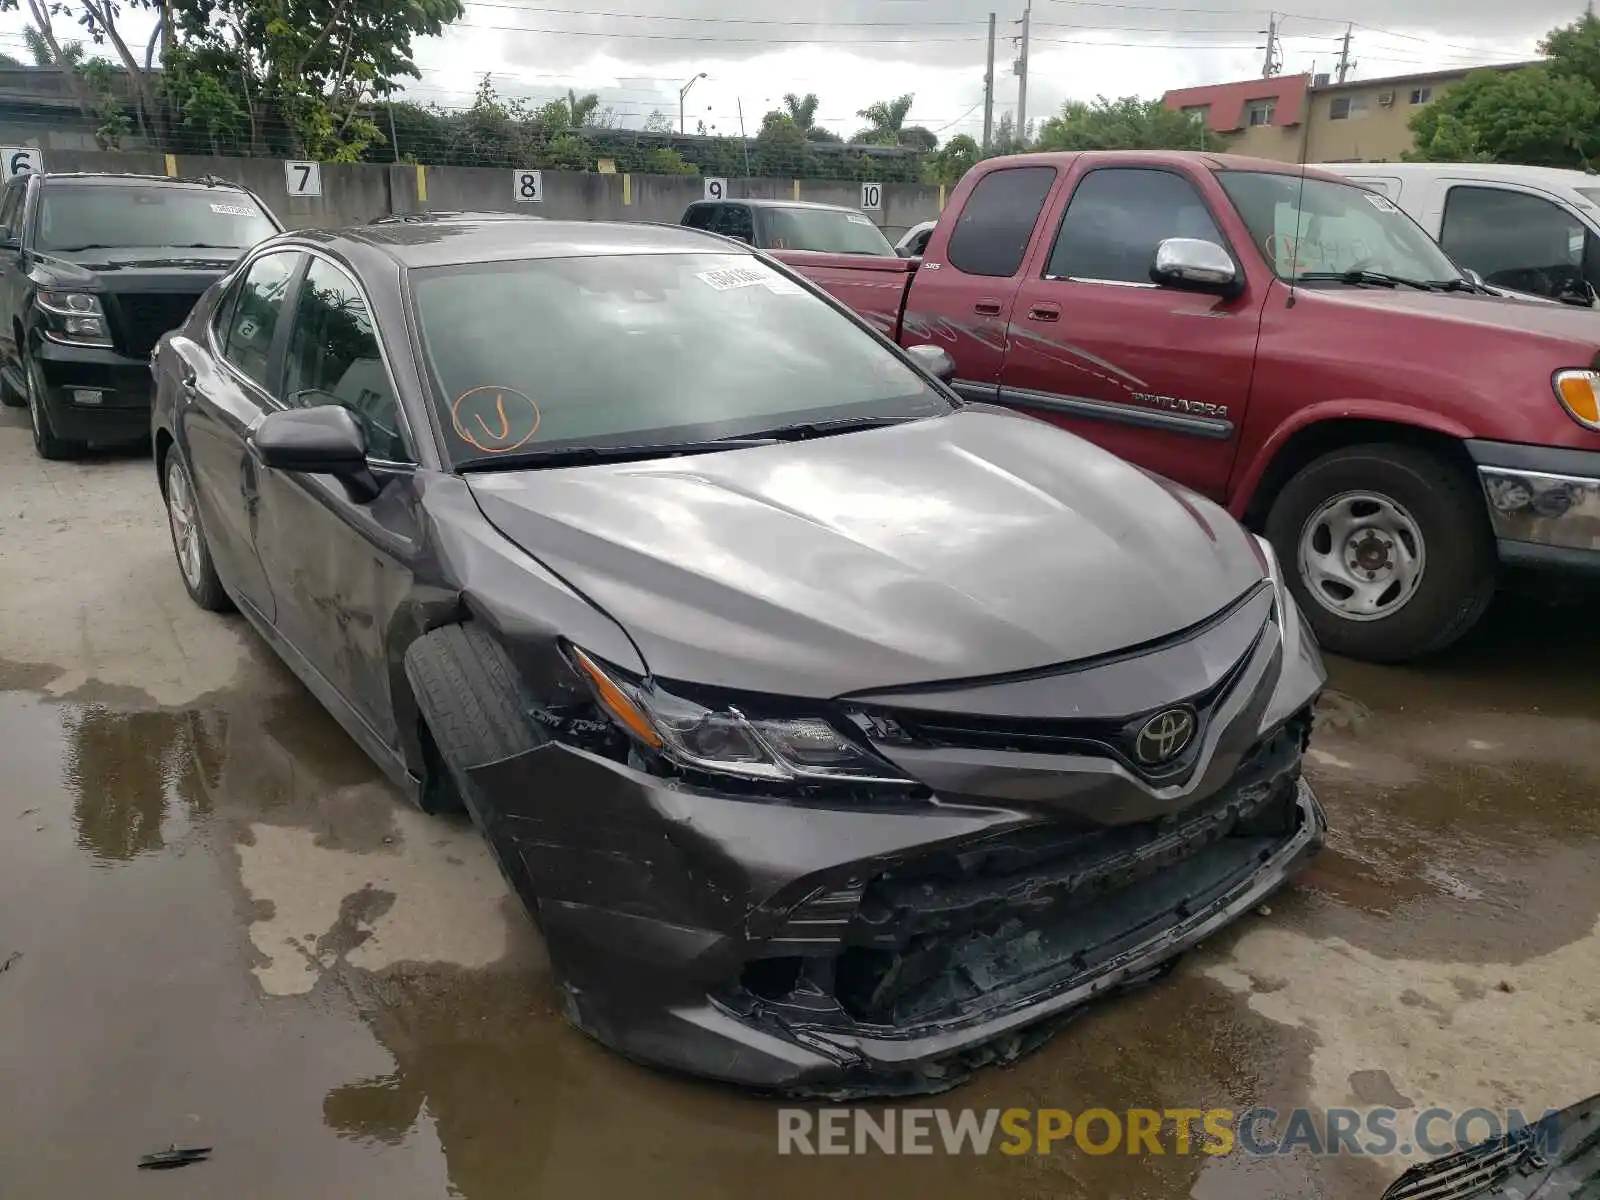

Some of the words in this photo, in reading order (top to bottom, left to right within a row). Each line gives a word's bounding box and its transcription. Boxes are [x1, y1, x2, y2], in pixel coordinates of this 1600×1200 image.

[11, 152, 31, 175] 6
[293, 165, 311, 191] 7
[520, 174, 536, 198] 8
[709, 181, 722, 200] 9
[863, 186, 879, 207] 10
[1159, 395, 1229, 417] TUNDRA
